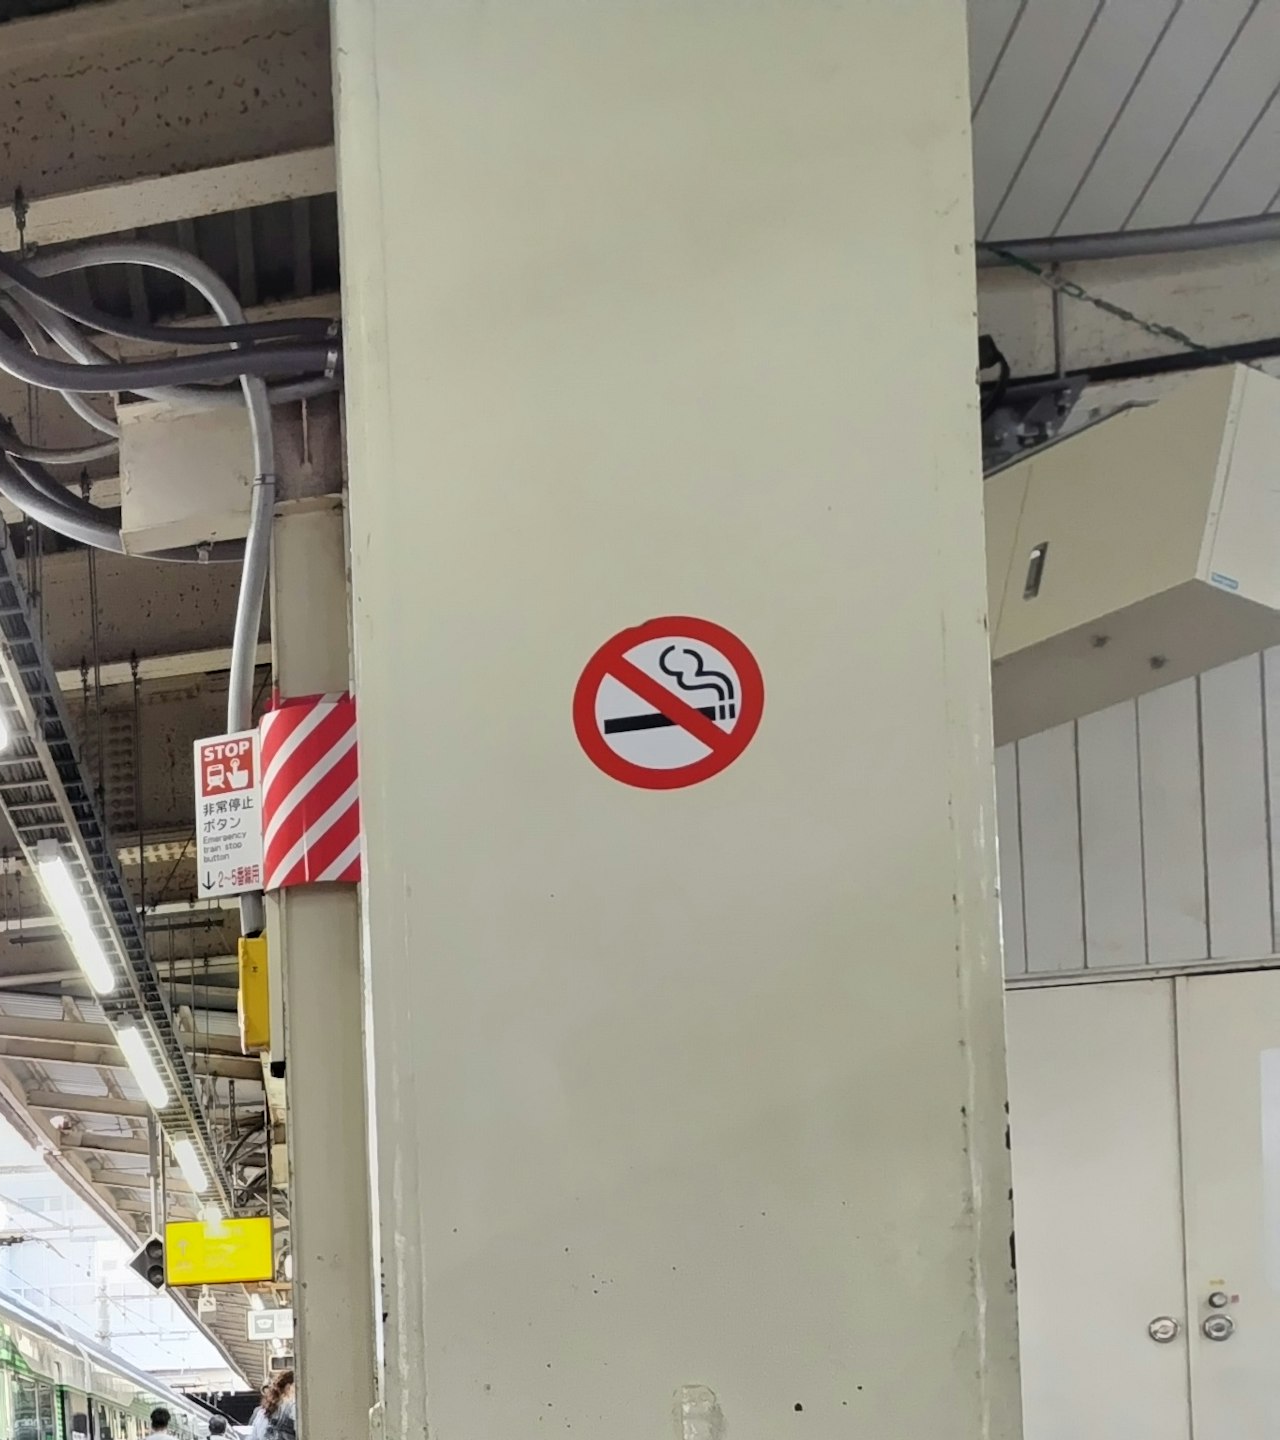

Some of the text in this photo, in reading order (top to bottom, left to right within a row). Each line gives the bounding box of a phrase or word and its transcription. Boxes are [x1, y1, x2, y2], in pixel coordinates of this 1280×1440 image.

[204, 740, 250, 762] STOP
[203, 796, 254, 817] 非常停止
[203, 817, 241, 834] ボタン
[203, 831, 247, 844] Emergency
[203, 842, 243, 854] train stop
[203, 853, 230, 863] button
